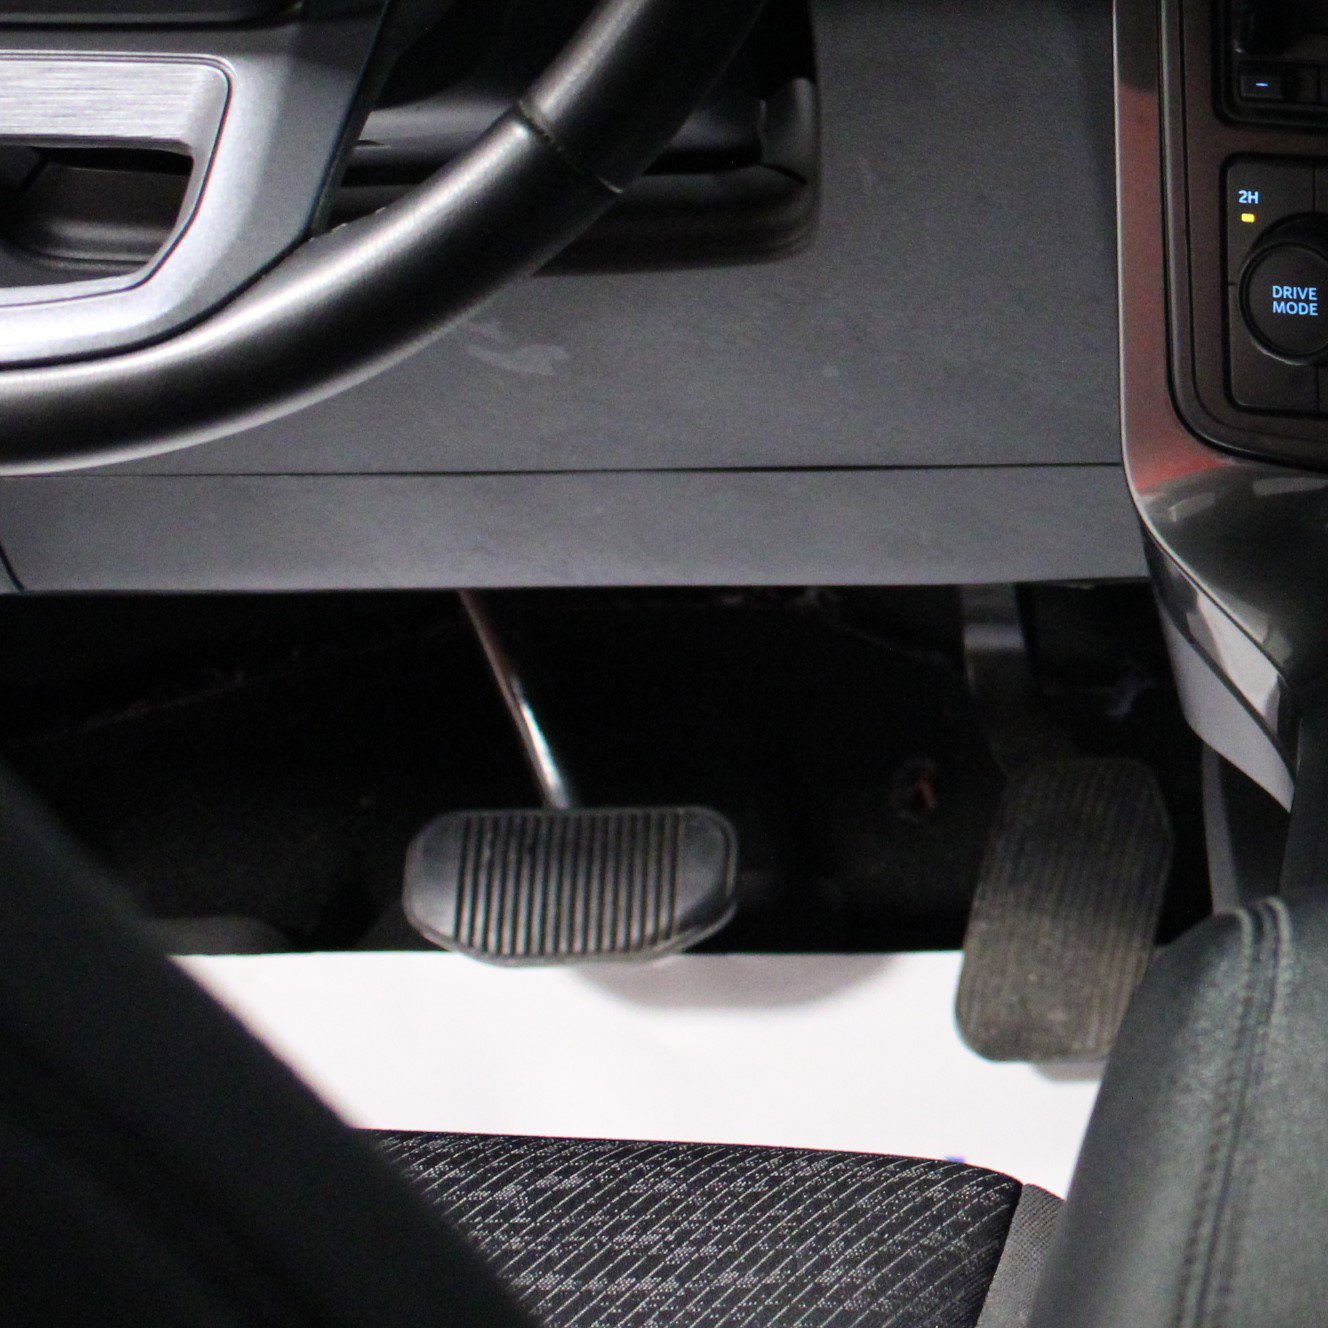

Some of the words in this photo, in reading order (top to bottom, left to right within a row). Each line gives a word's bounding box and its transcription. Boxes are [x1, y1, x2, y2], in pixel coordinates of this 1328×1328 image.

[1238, 189, 1259, 205] 2H
[1272, 285, 1318, 301] DRIVE
[1272, 301, 1319, 316] MODE
